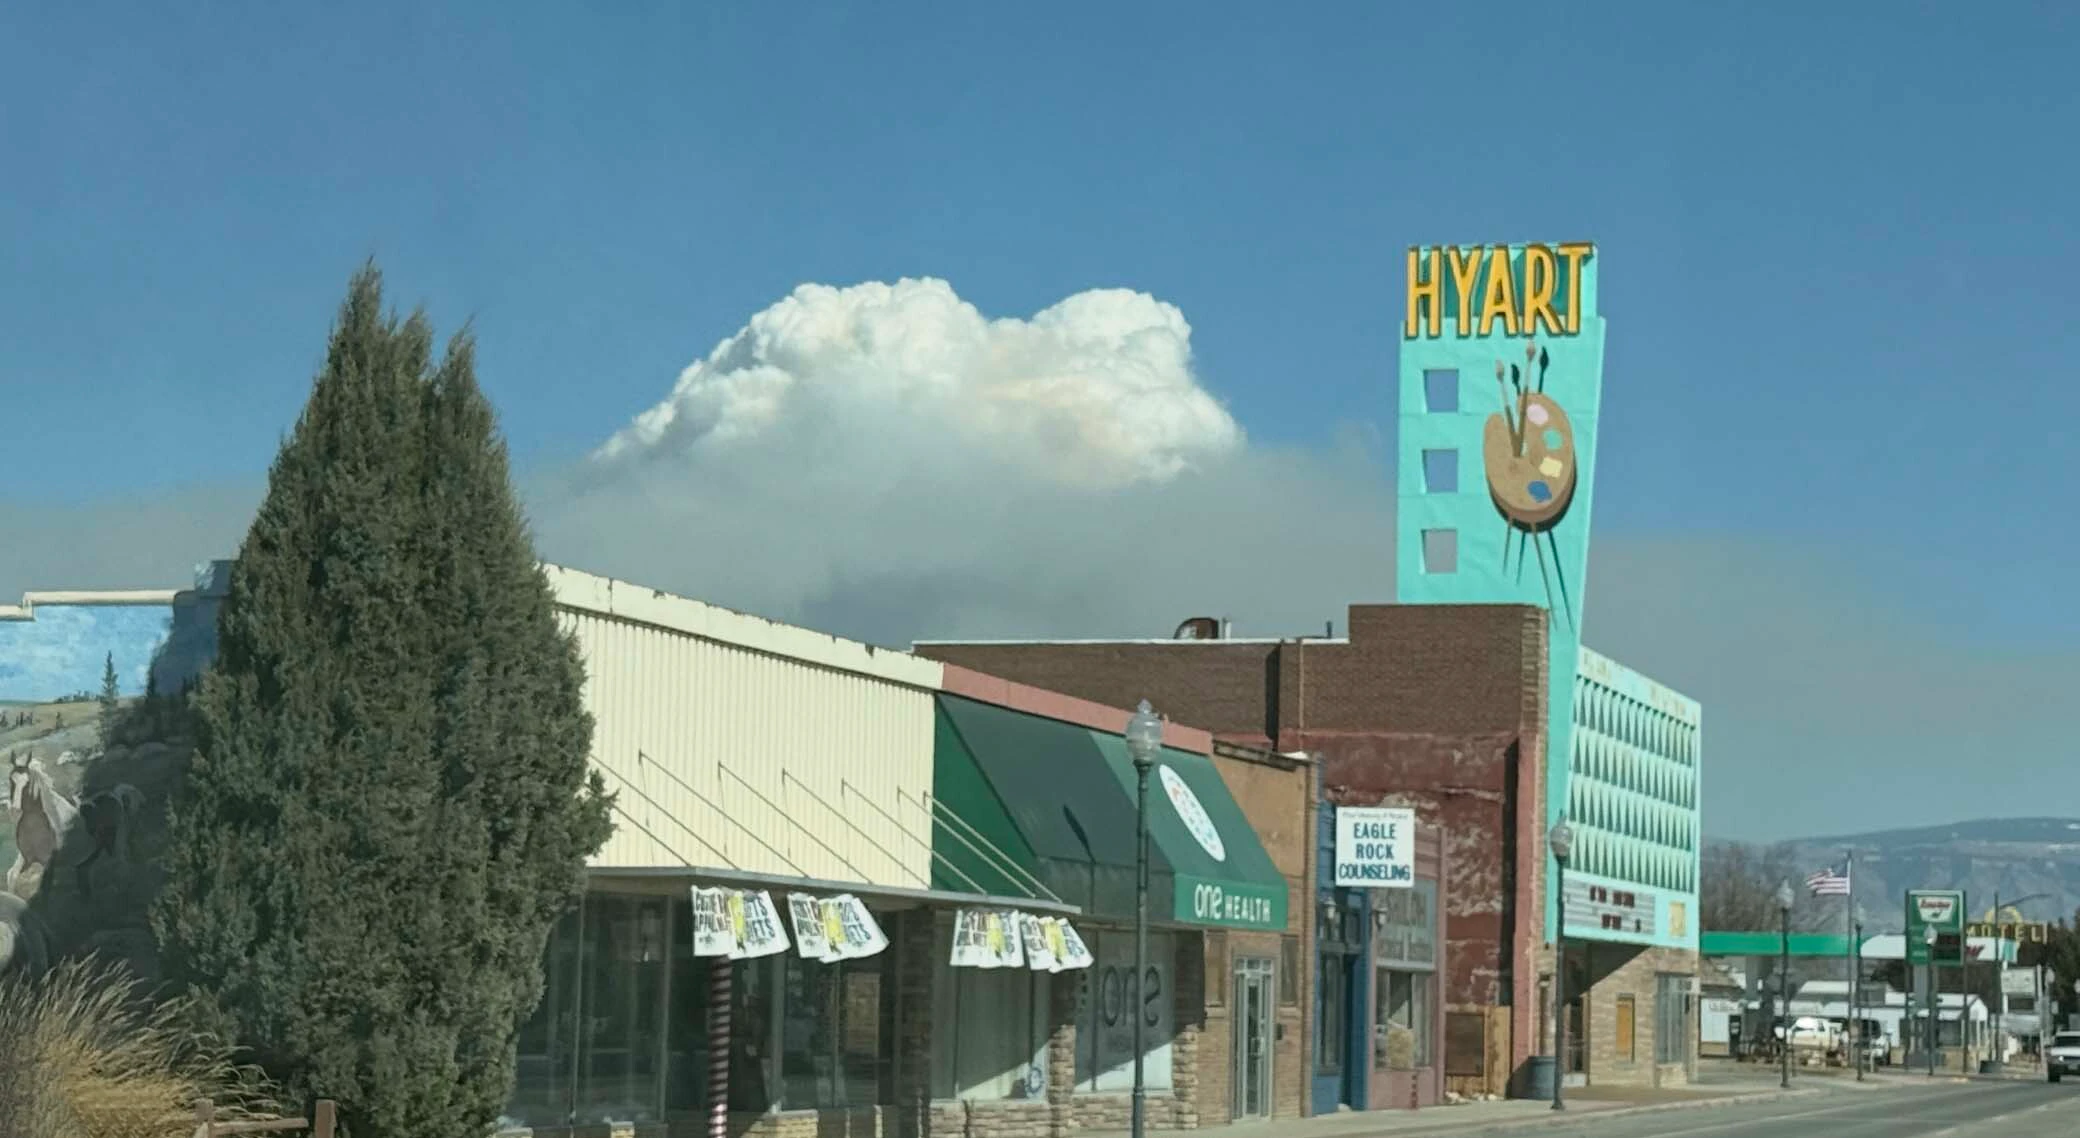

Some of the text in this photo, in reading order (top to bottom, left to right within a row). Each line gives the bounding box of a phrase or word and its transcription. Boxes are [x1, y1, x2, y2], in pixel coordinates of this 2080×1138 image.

[1404, 242, 1593, 340] HYART
[1353, 822, 1397, 840] EAGLE
[1355, 843, 1394, 860] ROCK
[1339, 863, 1411, 881] COUNSELING
[1225, 894, 1271, 922] HEALTH
